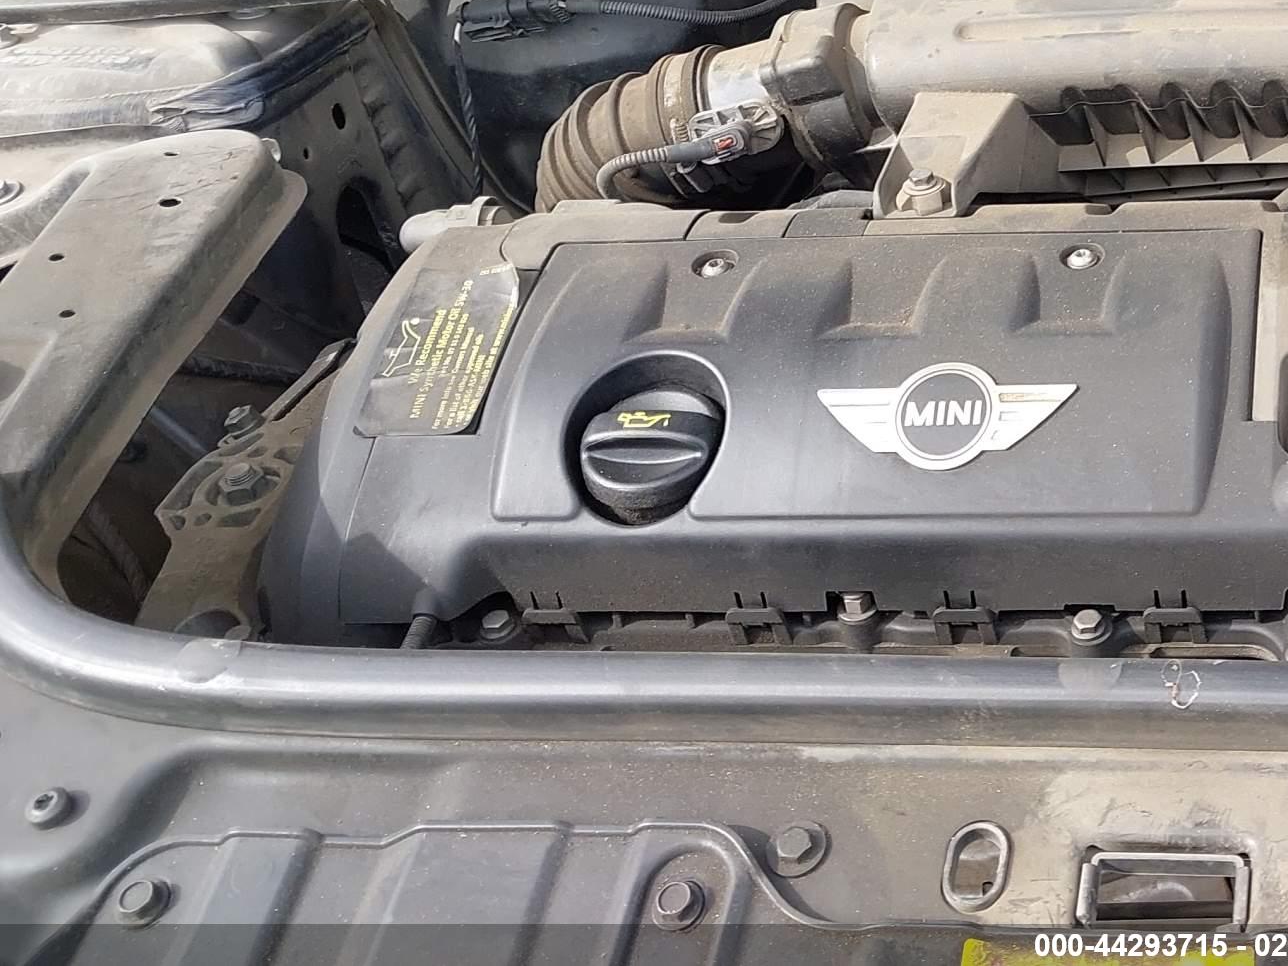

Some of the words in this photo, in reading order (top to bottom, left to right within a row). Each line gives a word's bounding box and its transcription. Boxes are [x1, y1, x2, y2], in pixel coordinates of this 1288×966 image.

[454, 280, 473, 307] 5W-30
[448, 307, 461, 320] Oil
[408, 368, 423, 384] We
[416, 310, 447, 365] Recommend
[435, 320, 455, 348] Motor
[419, 349, 445, 392] Synthetic
[410, 395, 427, 419] MINI
[904, 400, 983, 427] MINI
